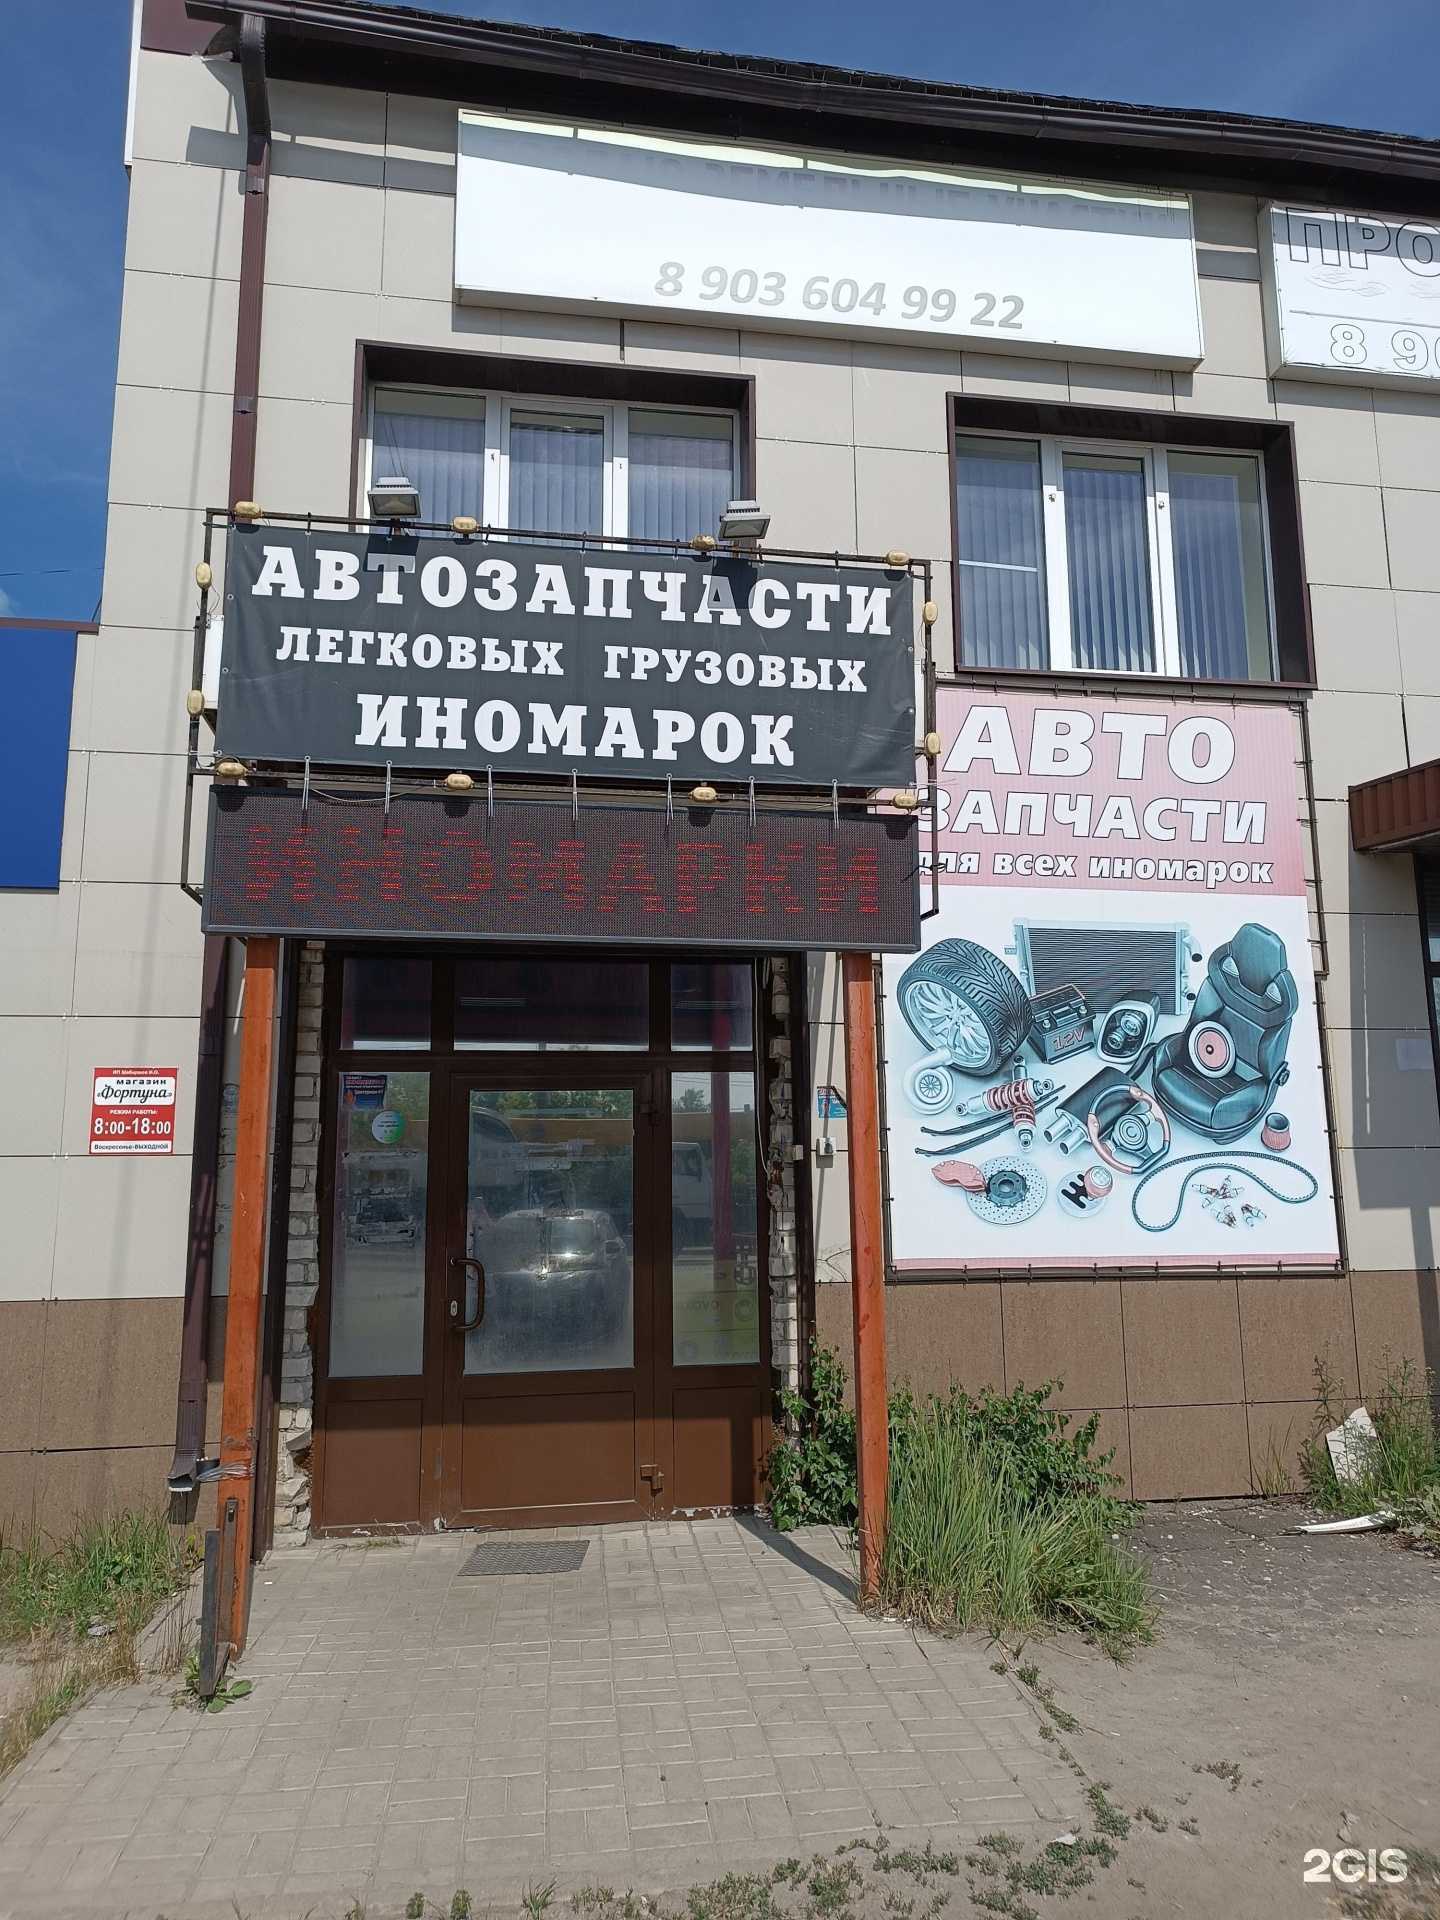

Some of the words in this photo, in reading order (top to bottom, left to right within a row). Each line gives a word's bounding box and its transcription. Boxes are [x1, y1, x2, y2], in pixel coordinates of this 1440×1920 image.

[654, 261, 686, 297] 8
[699, 265, 786, 306] 903
[802, 275, 886, 315] 604
[901, 285, 956, 322] 99
[970, 292, 1024, 329] 22
[1330, 323, 1367, 364] 8
[251, 545, 892, 636] АВТОЗАПЧАСТИ
[275, 625, 564, 677] ЛЕГКОВЫХ
[603, 645, 868, 693] ГРУЗОВЫХ
[354, 693, 795, 767] ИНОМАРОК
[942, 705, 1236, 785] АВТО
[917, 787, 1267, 845] ЗАПЧАСТИ
[244, 824, 879, 915] ИНОМАРКИ
[992, 852, 1078, 878] всех
[1088, 855, 1274, 890] иномарок
[1053, 1025, 1086, 1050] 12V
[94, 1117, 171, 1135] 8:00-18:00
